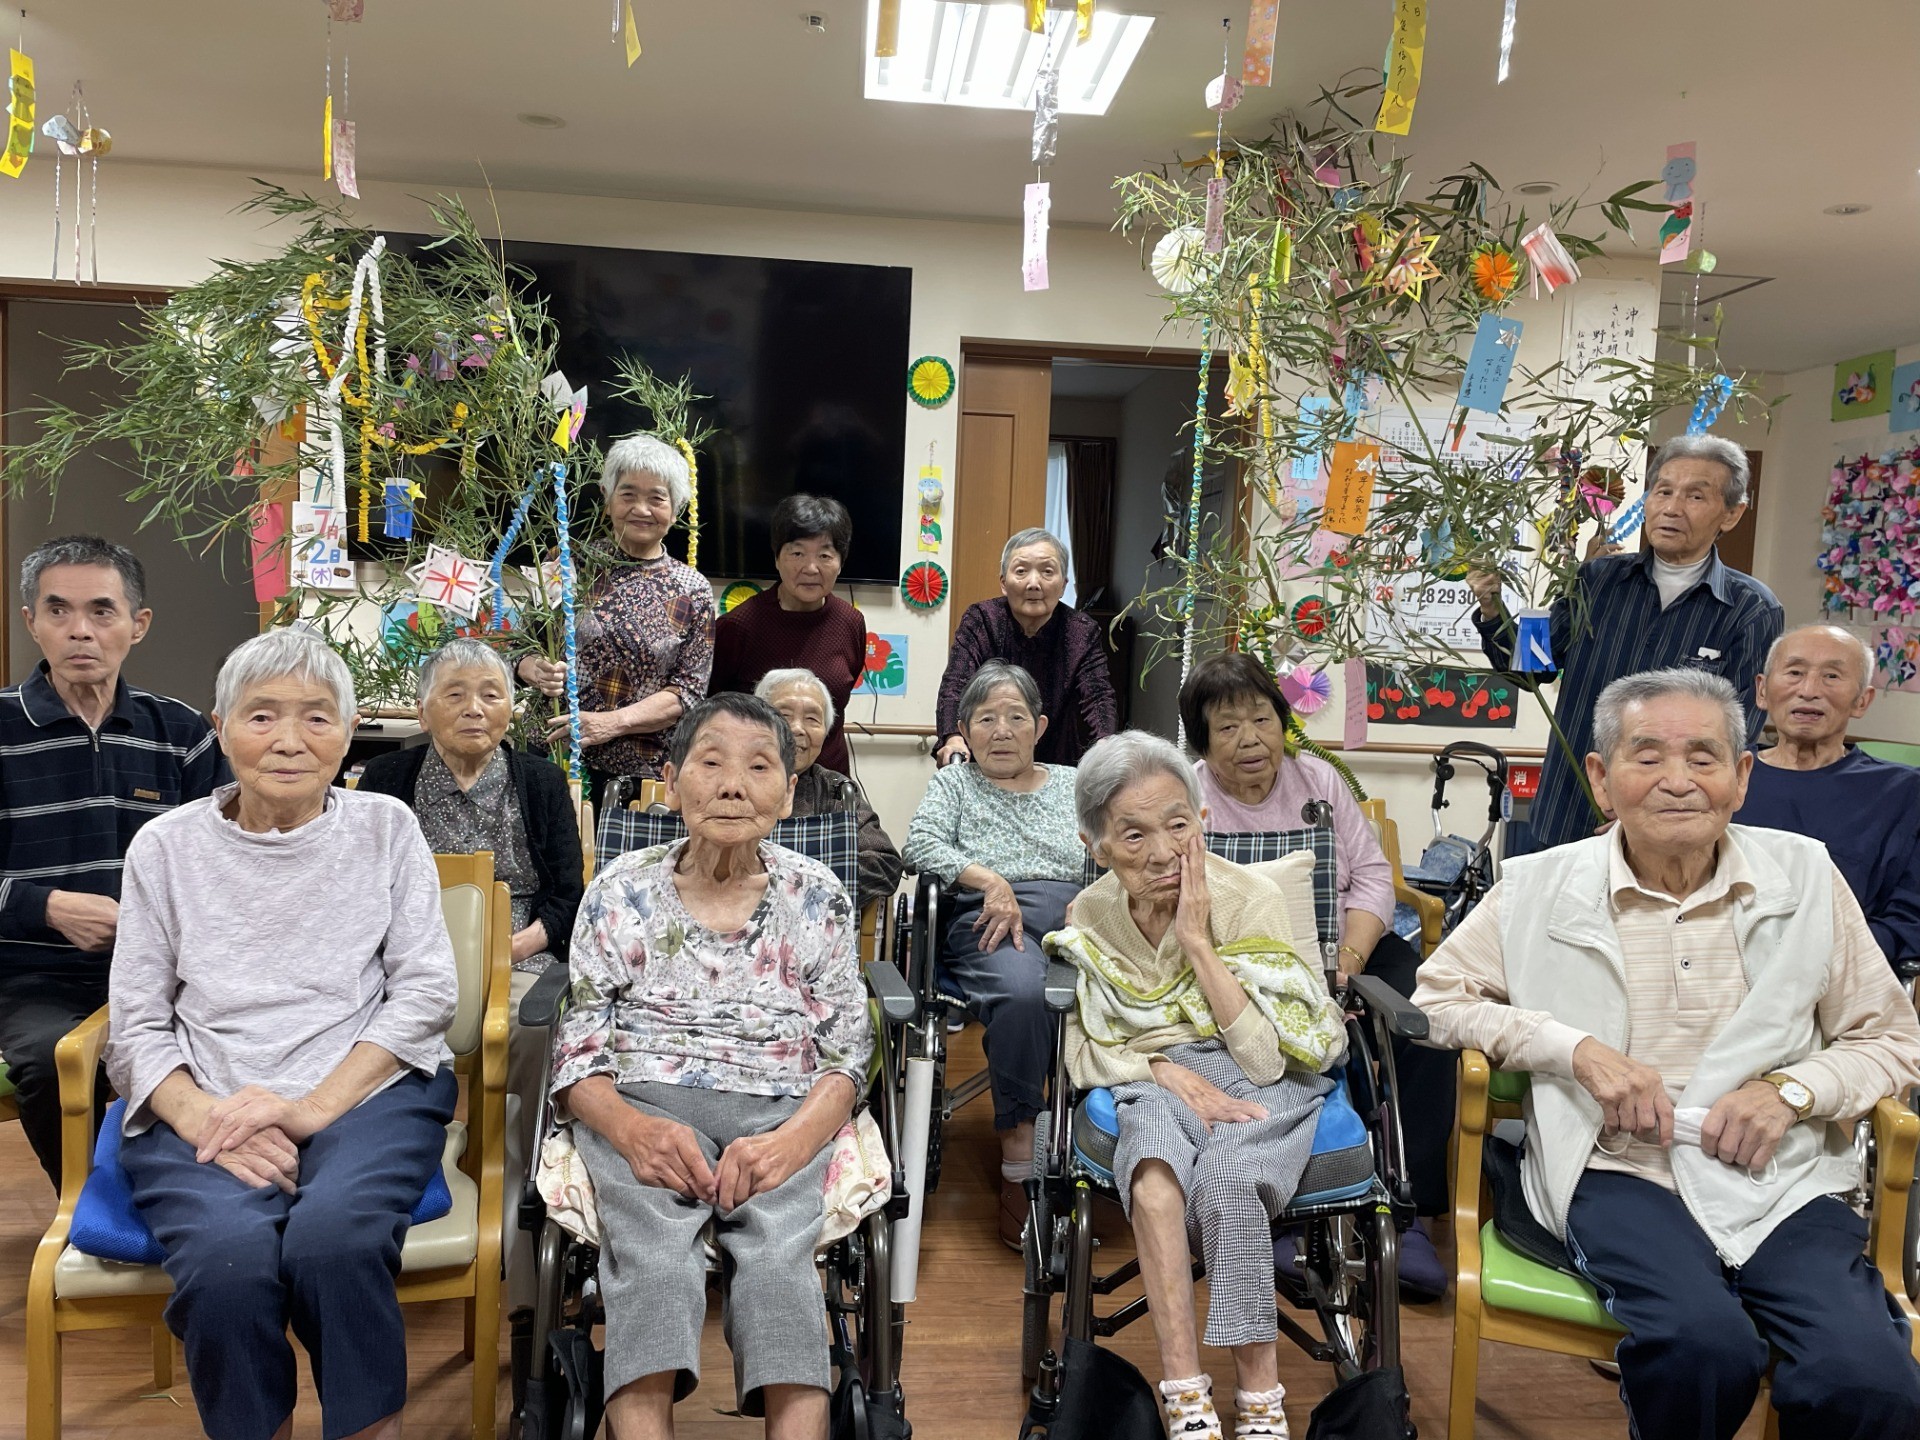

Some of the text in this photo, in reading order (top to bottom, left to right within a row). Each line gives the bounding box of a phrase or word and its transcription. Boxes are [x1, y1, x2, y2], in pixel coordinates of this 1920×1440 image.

[1448, 422, 1467, 452] 7
[1352, 475, 1368, 522] 早く病気が
[314, 510, 339, 540] 7月
[309, 539, 341, 565] 2日
[311, 567, 333, 587] (木)
[1437, 589, 1455, 604] 29
[1457, 590, 1476, 604] 30
